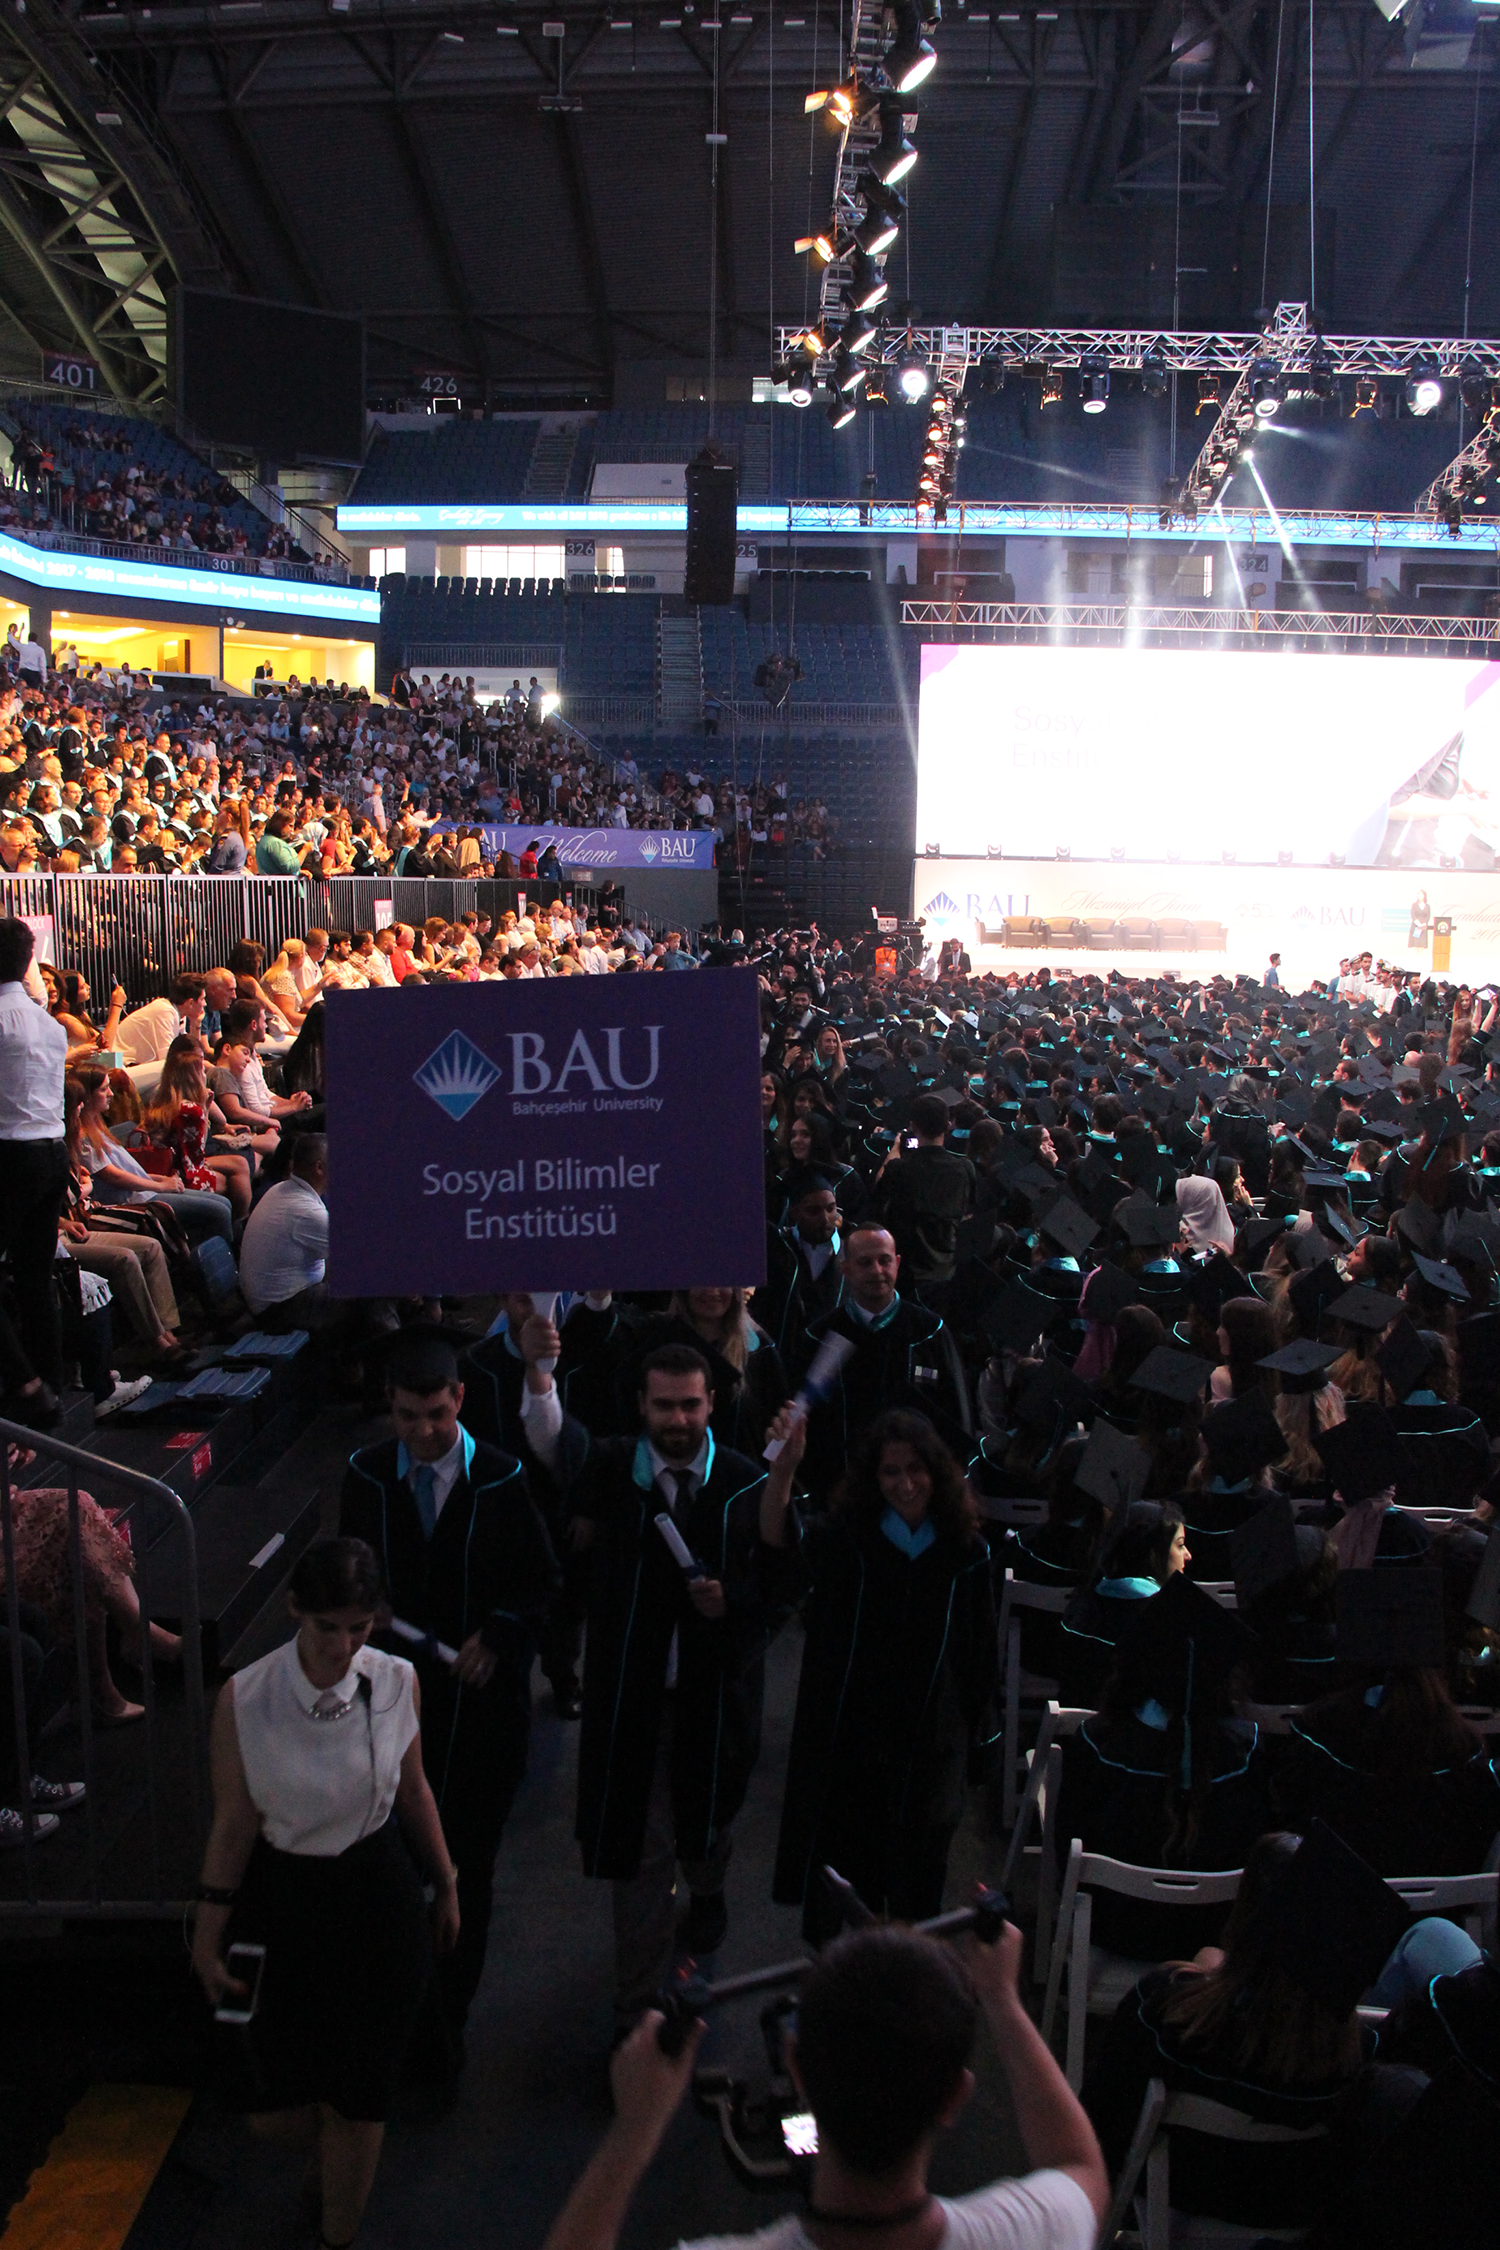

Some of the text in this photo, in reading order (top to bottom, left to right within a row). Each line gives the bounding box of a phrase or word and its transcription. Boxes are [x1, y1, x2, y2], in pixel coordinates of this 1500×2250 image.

[49, 361, 94, 389] 401
[420, 376, 457, 394] 426
[567, 542, 594, 556] 326
[737, 543, 757, 557] 25
[211, 558, 235, 572] 301
[1238, 558, 1267, 572] 324
[534, 830, 618, 864] Welcome
[660, 837, 697, 858] BAU
[966, 894, 1032, 920] BAU
[1319, 905, 1366, 927] BAU
[505, 1025, 665, 1096] BAU
[513, 1096, 664, 1117] Bahçeşehir University
[423, 1155, 661, 1202] Sosyal Bilimler
[465, 1203, 617, 1240] Enstitüsü
